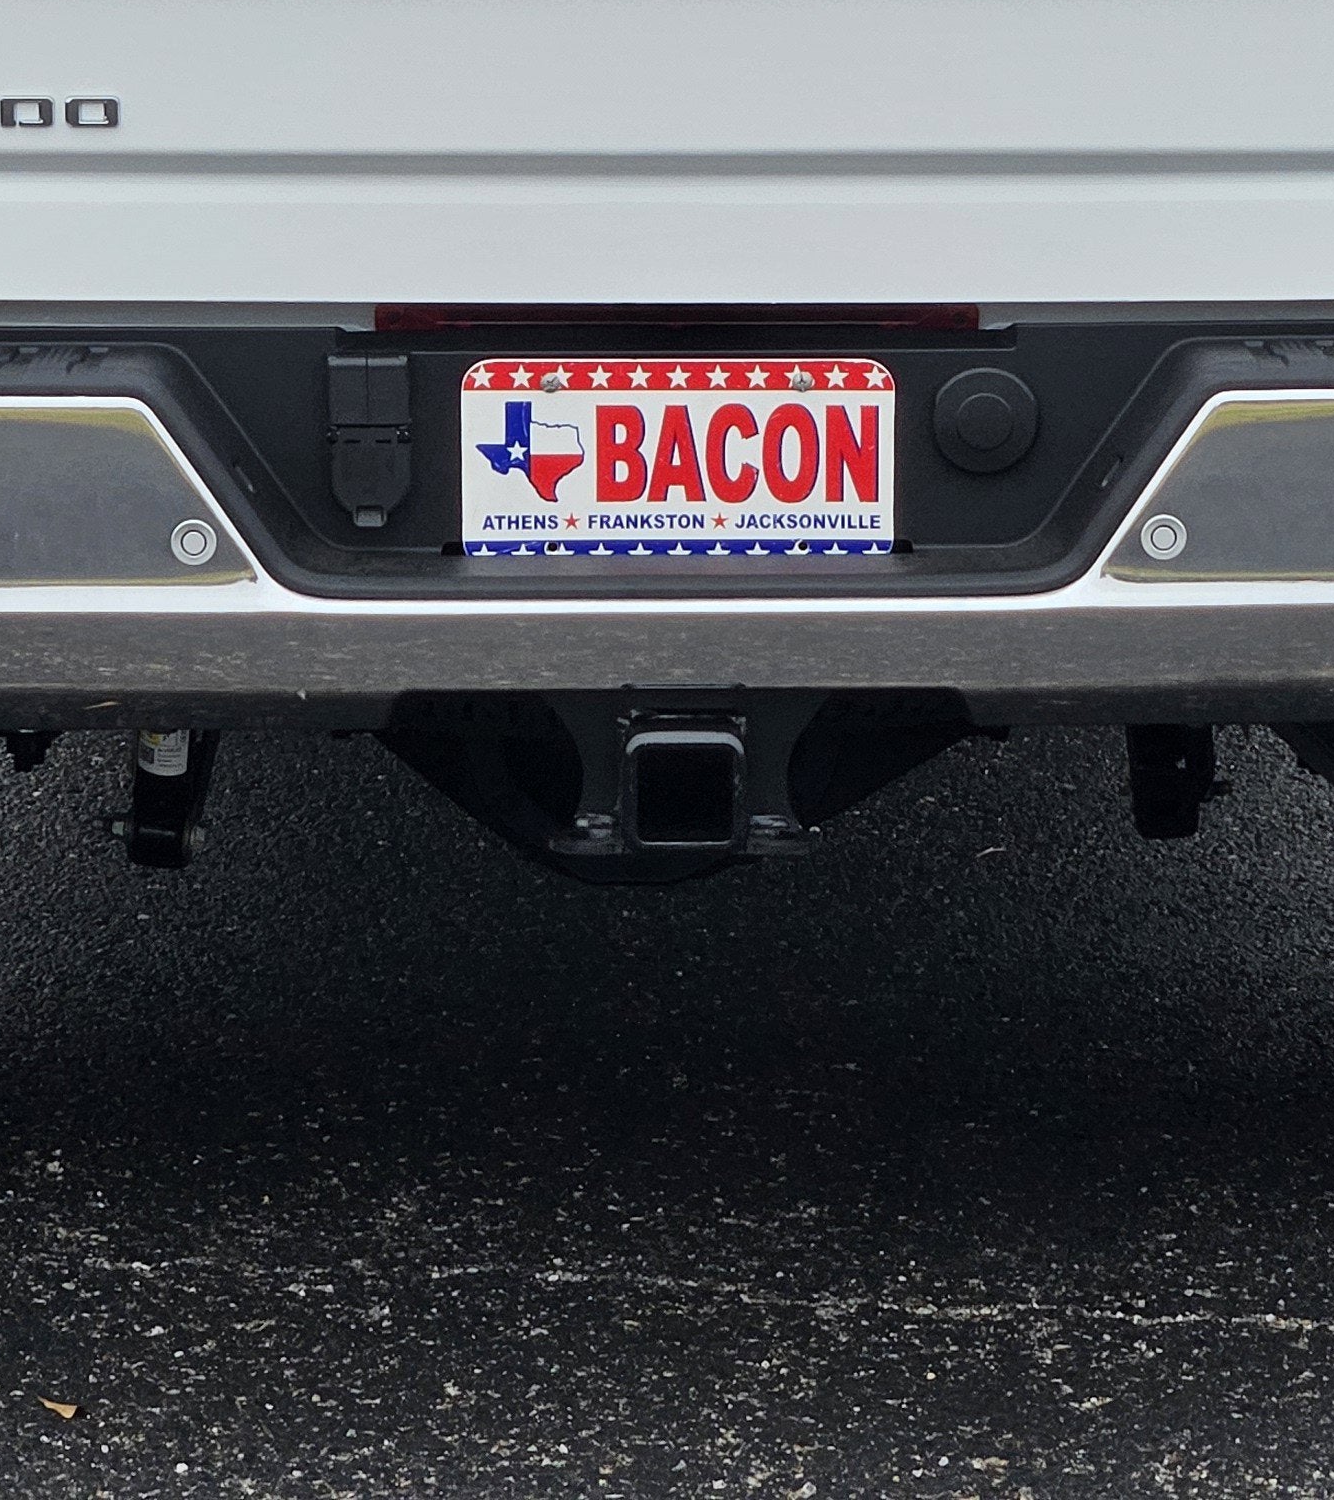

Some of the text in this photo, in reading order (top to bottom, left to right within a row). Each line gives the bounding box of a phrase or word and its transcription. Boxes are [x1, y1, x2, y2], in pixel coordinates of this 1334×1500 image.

[595, 403, 880, 503] BACON
[482, 514, 881, 531] ATHENS FRANKSTON JACKSONVILLE
